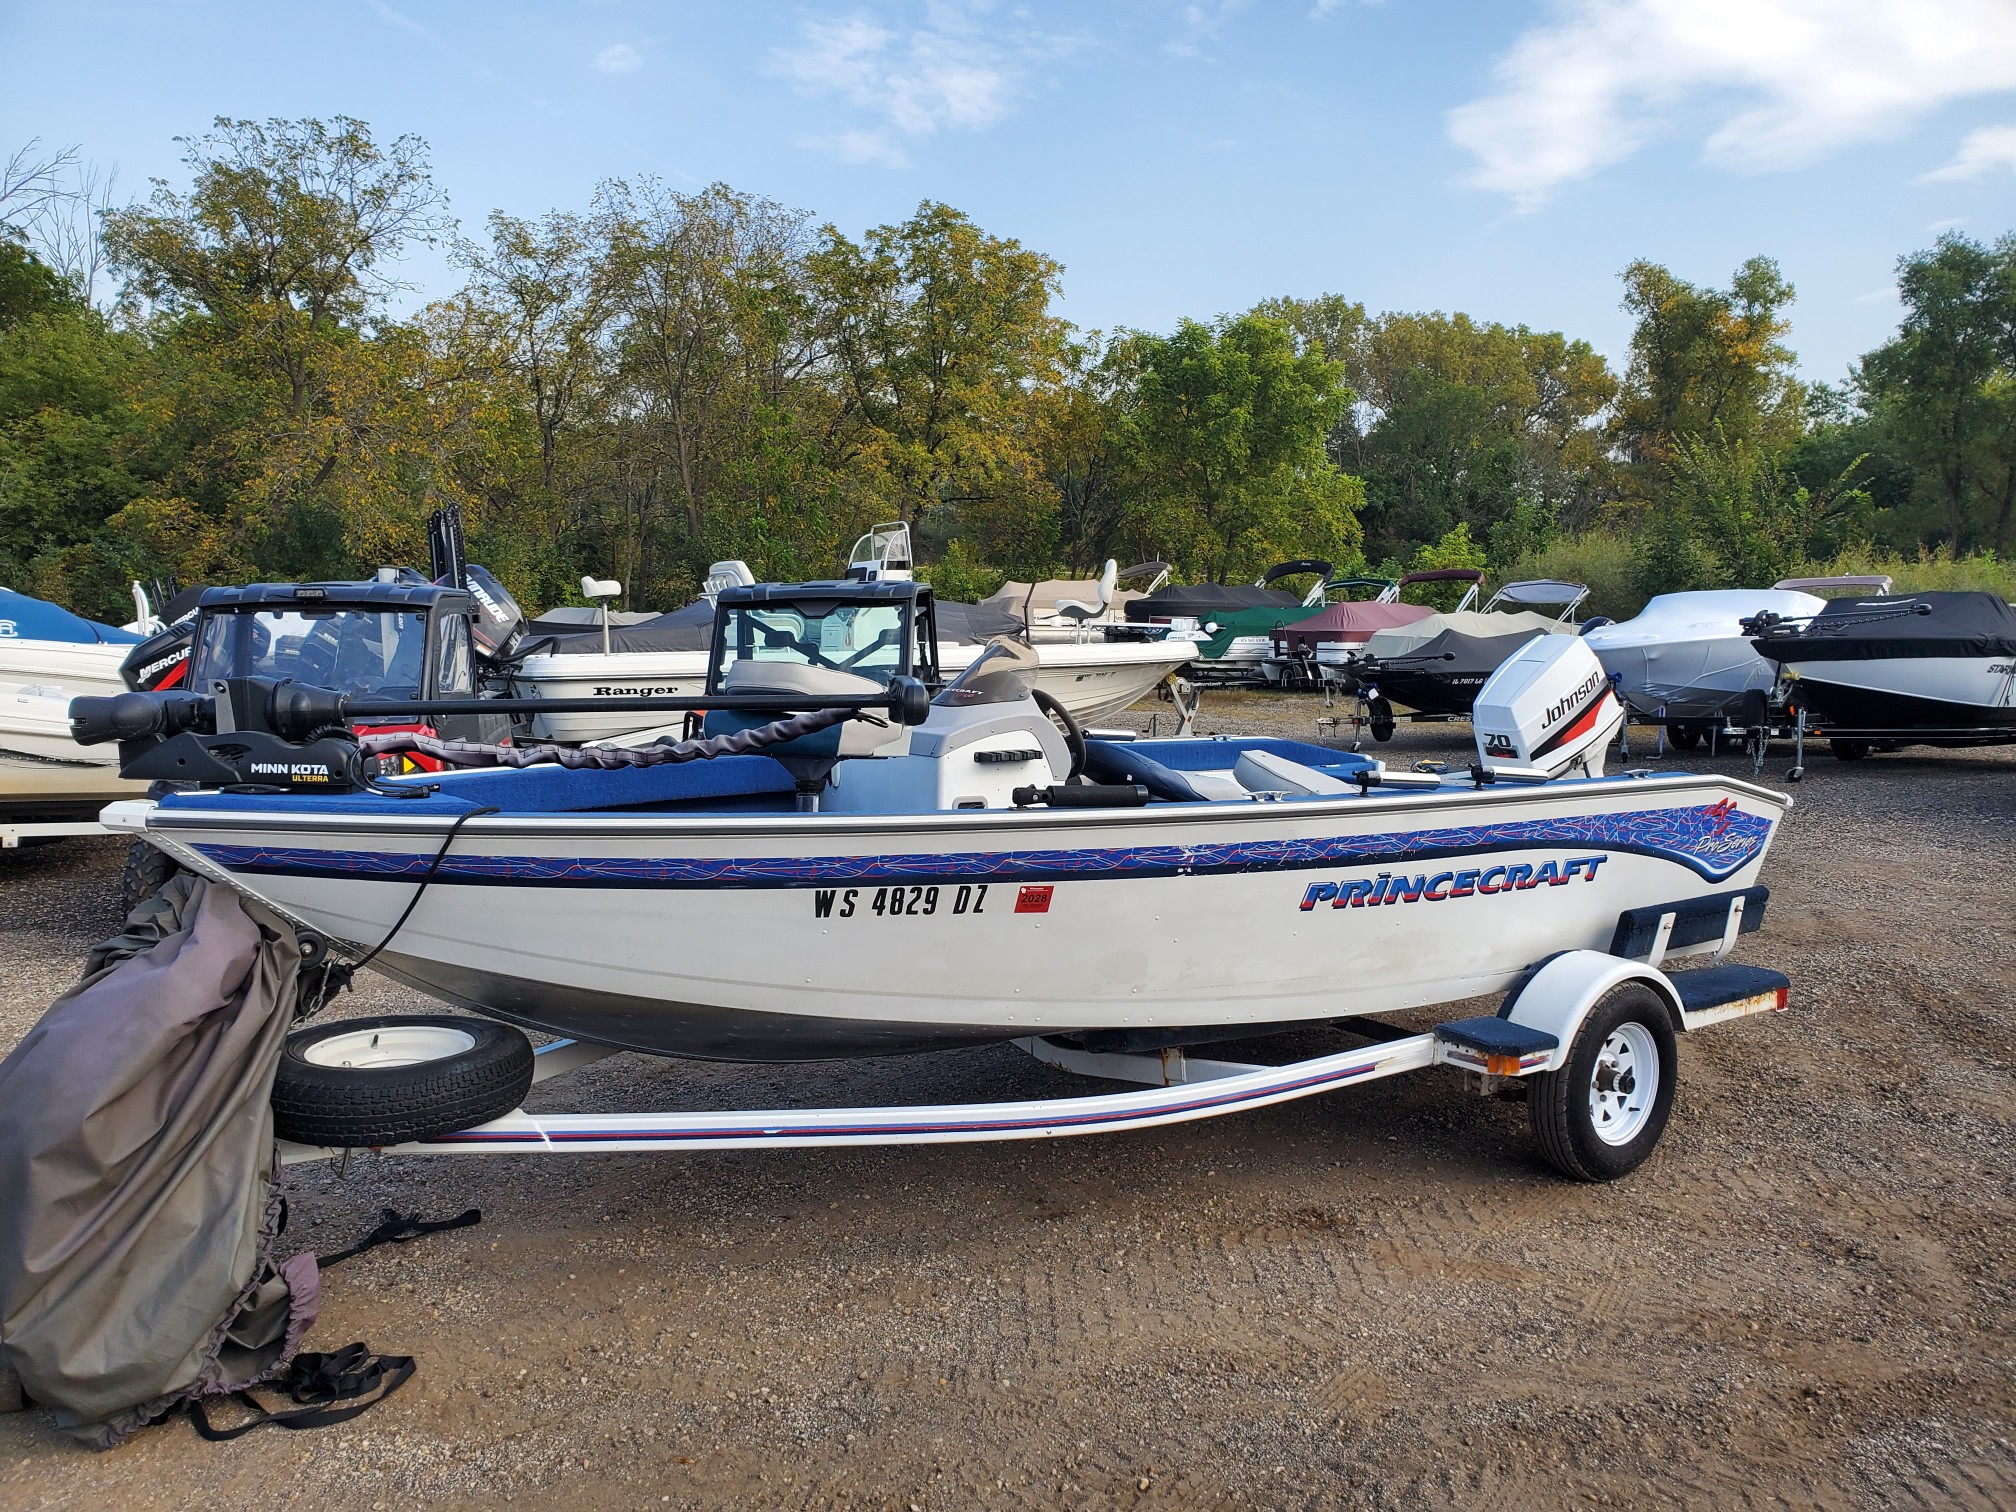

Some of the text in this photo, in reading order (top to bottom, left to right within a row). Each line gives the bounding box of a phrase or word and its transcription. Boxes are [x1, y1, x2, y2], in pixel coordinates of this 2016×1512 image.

[466, 573, 510, 623] VINRUDE
[592, 686, 679, 698] Ranger
[1541, 670, 1600, 730] Johnson
[1483, 732, 1513, 748] 70
[250, 762, 329, 775] MINN KOTA
[291, 774, 329, 783] ULTERRA
[814, 884, 989, 918] WS 4829 DZ
[1021, 893, 1048, 903] 2028
